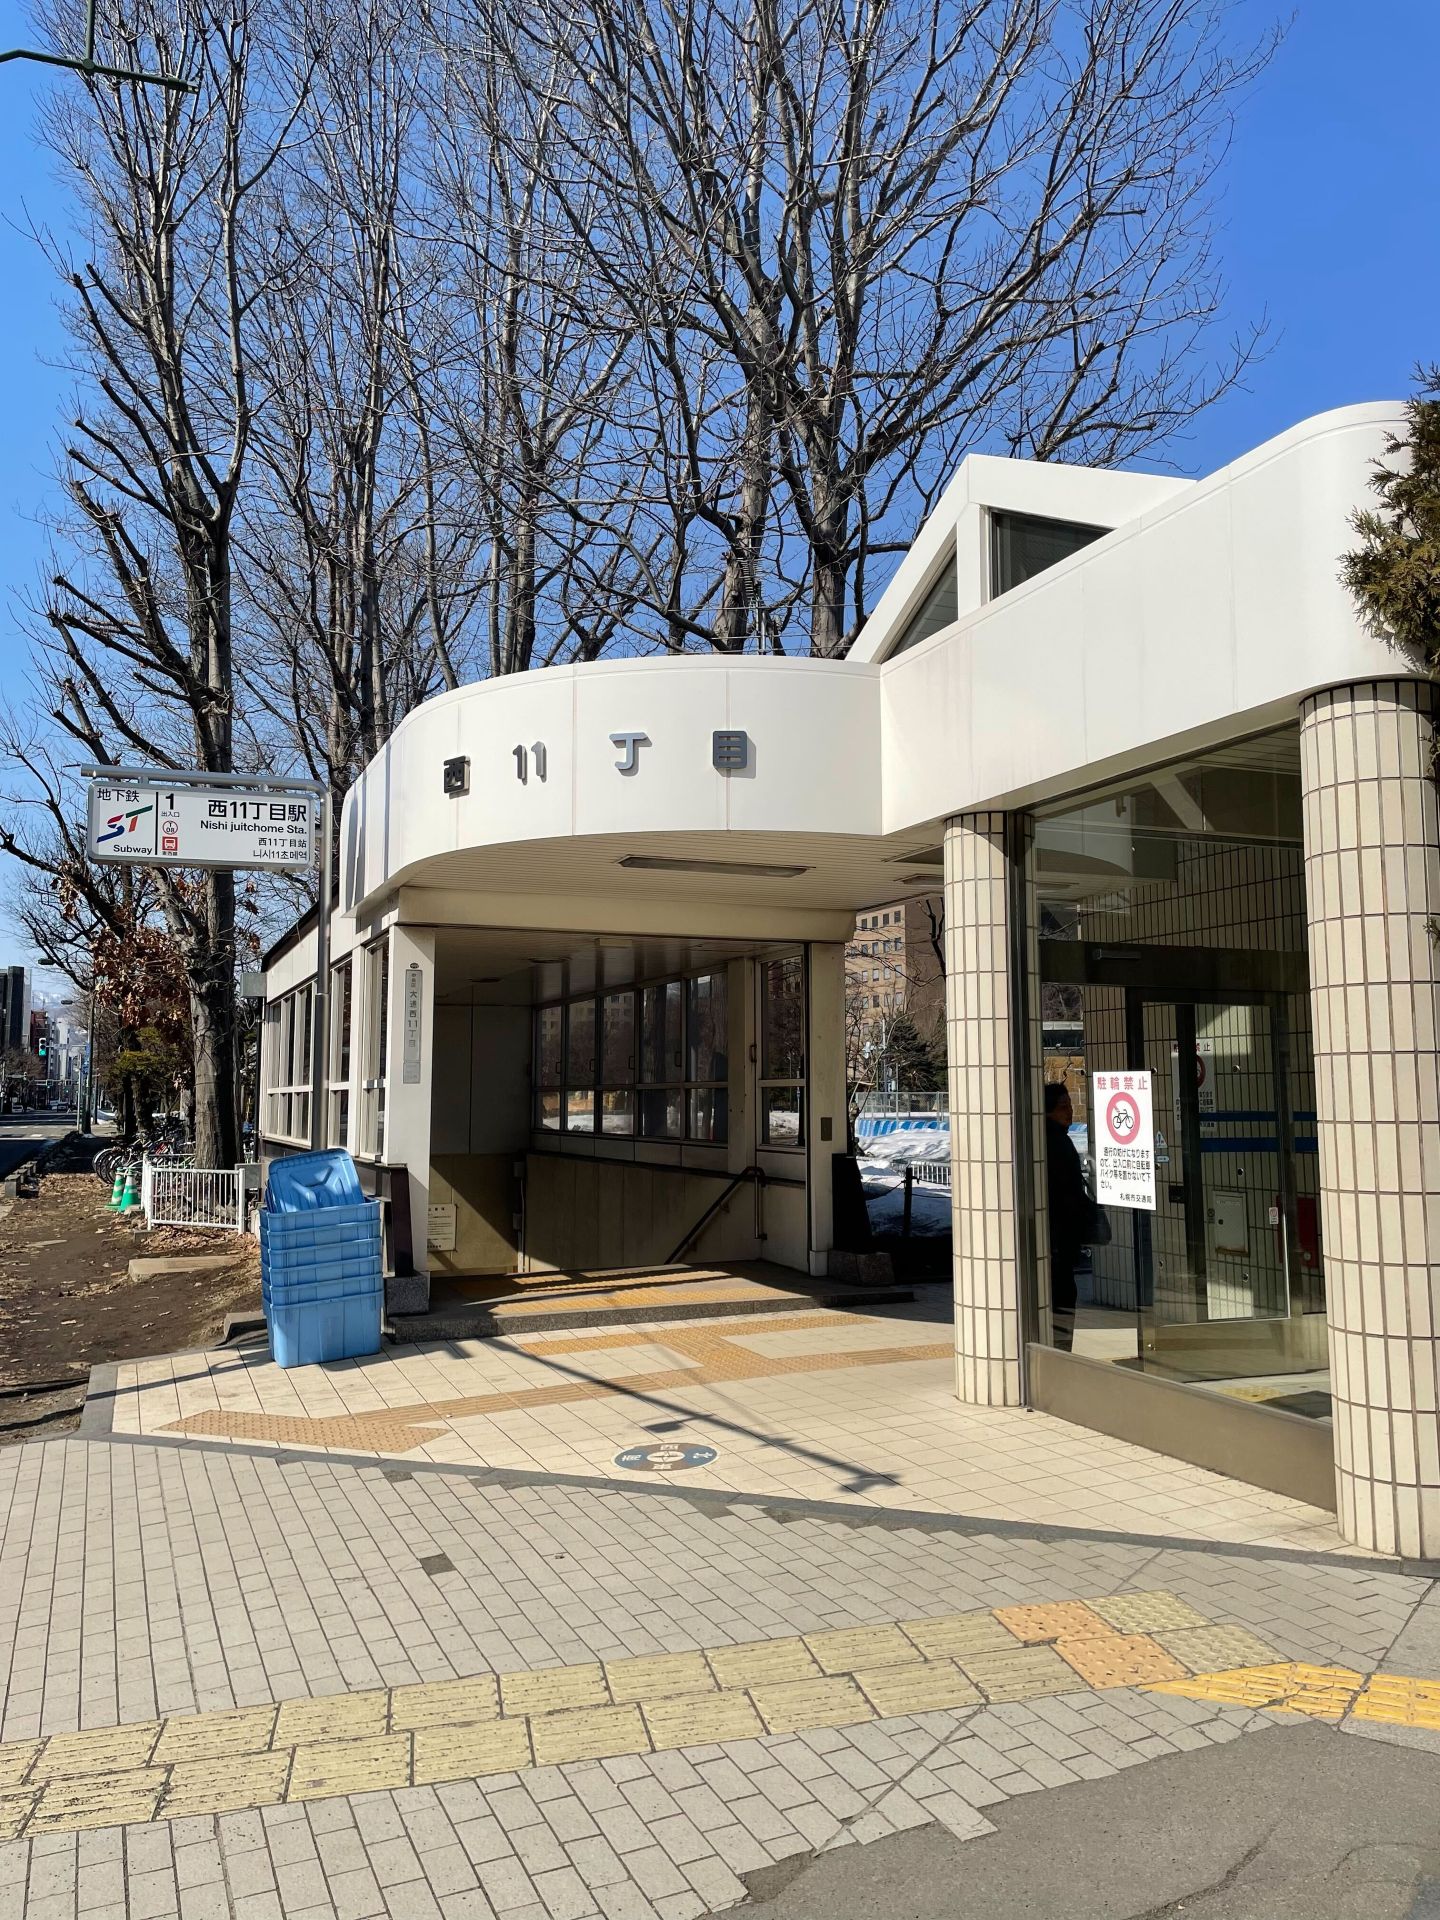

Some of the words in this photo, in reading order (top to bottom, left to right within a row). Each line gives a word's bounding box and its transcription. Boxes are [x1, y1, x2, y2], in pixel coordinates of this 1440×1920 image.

[443, 730, 748, 793] 西11丁目
[97, 788, 140, 802] 地下鉄
[165, 793, 174, 810] 1
[208, 799, 307, 822] 西11丁目駅
[200, 820, 228, 830] Nishi
[230, 822, 284, 833] juitchome
[286, 824, 307, 834] Sta.
[113, 844, 153, 855] Subway
[258, 837, 307, 848] 西11丁目站
[1097, 1076, 1148, 1090] 駐輪禁止
